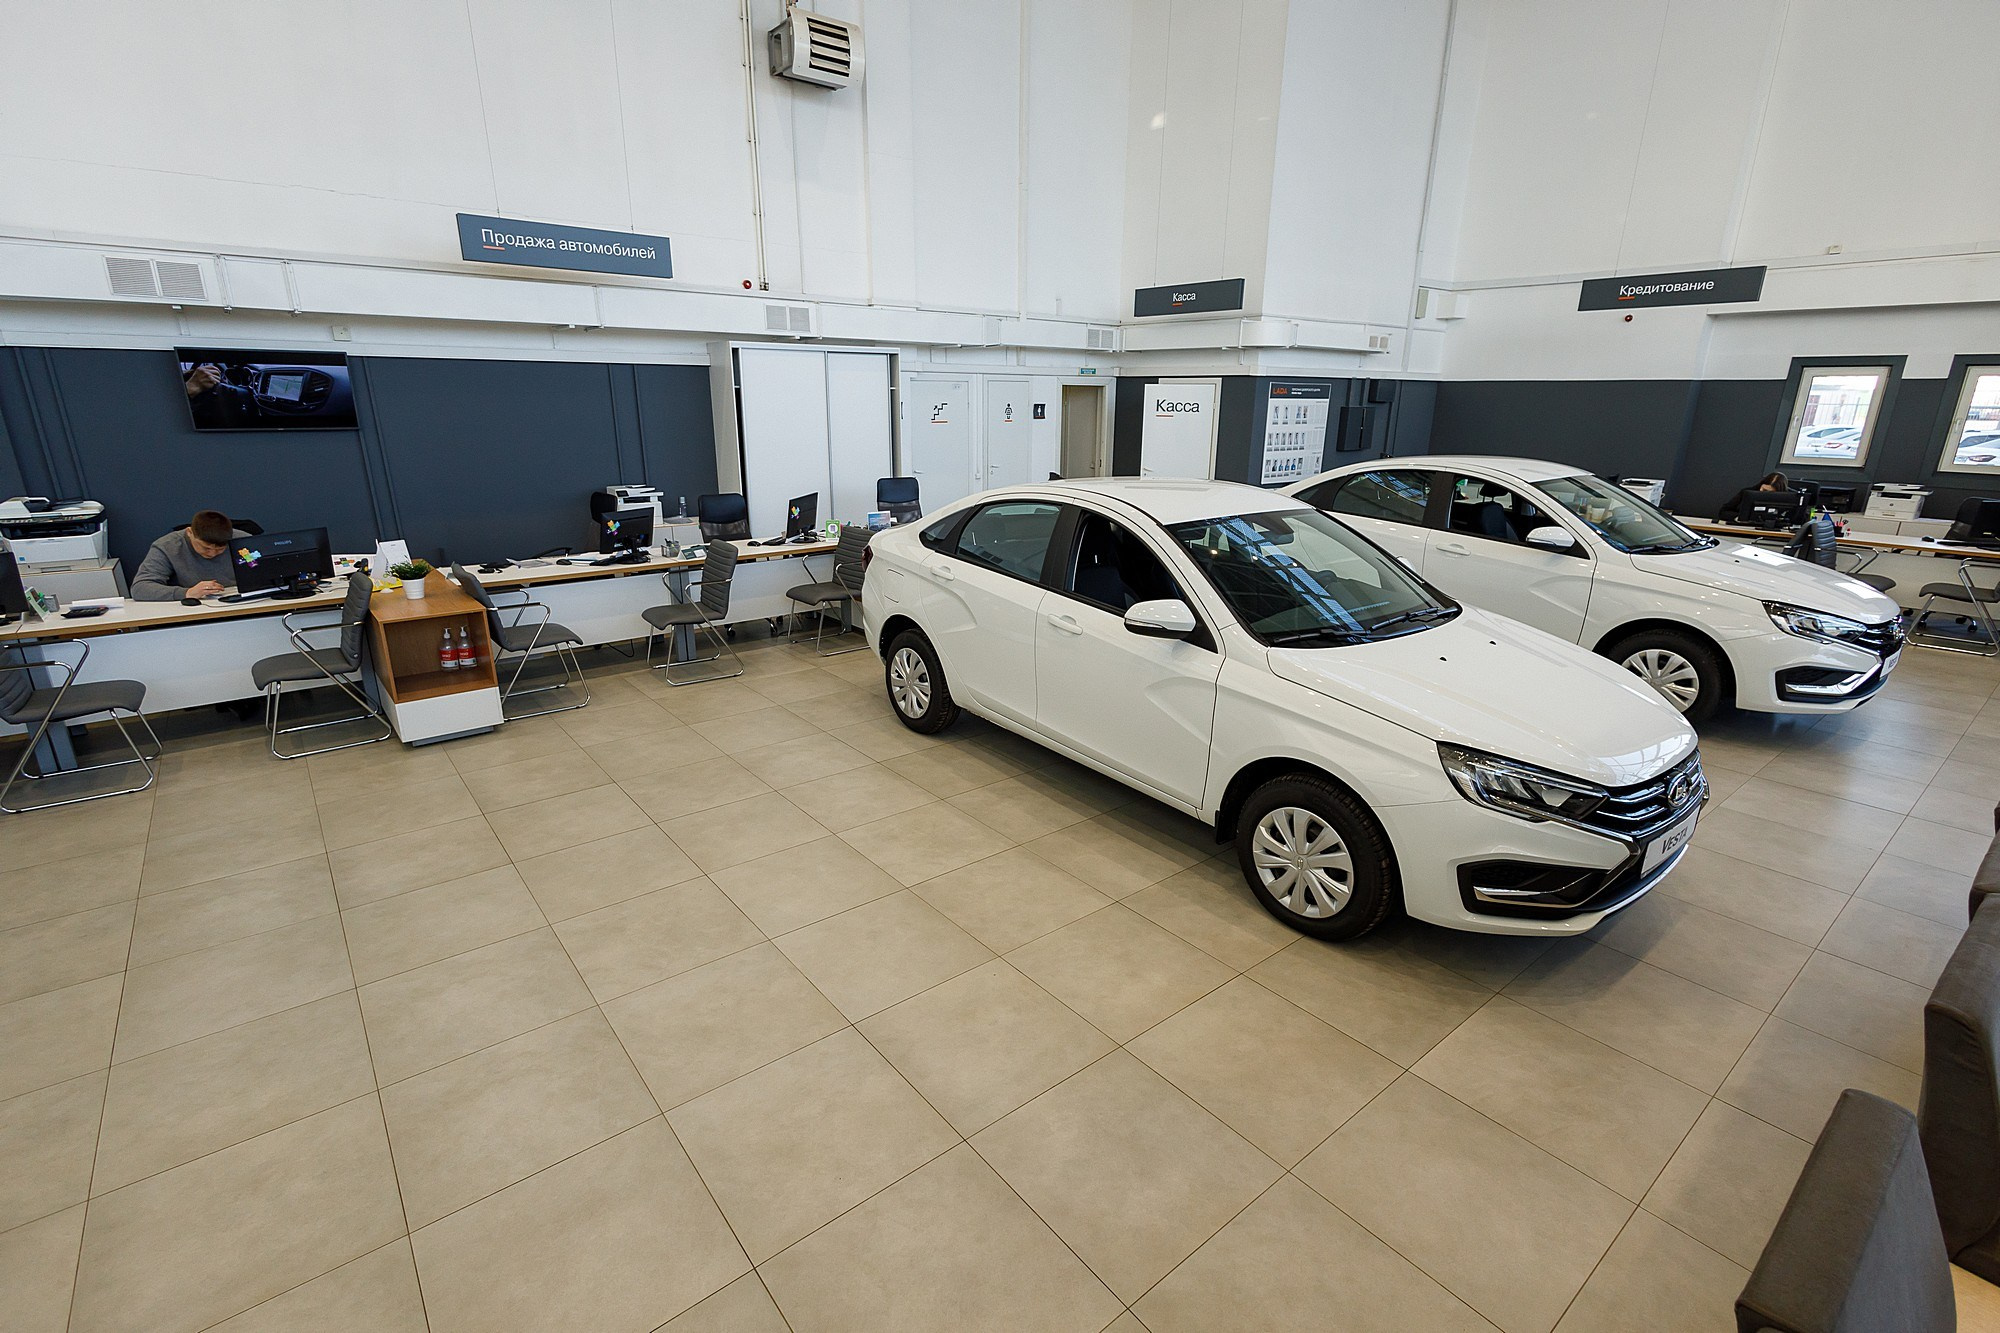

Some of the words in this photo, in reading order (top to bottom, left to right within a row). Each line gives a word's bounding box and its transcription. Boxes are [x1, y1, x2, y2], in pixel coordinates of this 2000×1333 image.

[481, 228, 556, 250] Продажа
[559, 239, 656, 260] автомобилей
[1619, 280, 1714, 297] Кредитование
[1172, 292, 1196, 302] Касса
[1273, 387, 1288, 395] LADA
[1156, 399, 1200, 413] Касса
